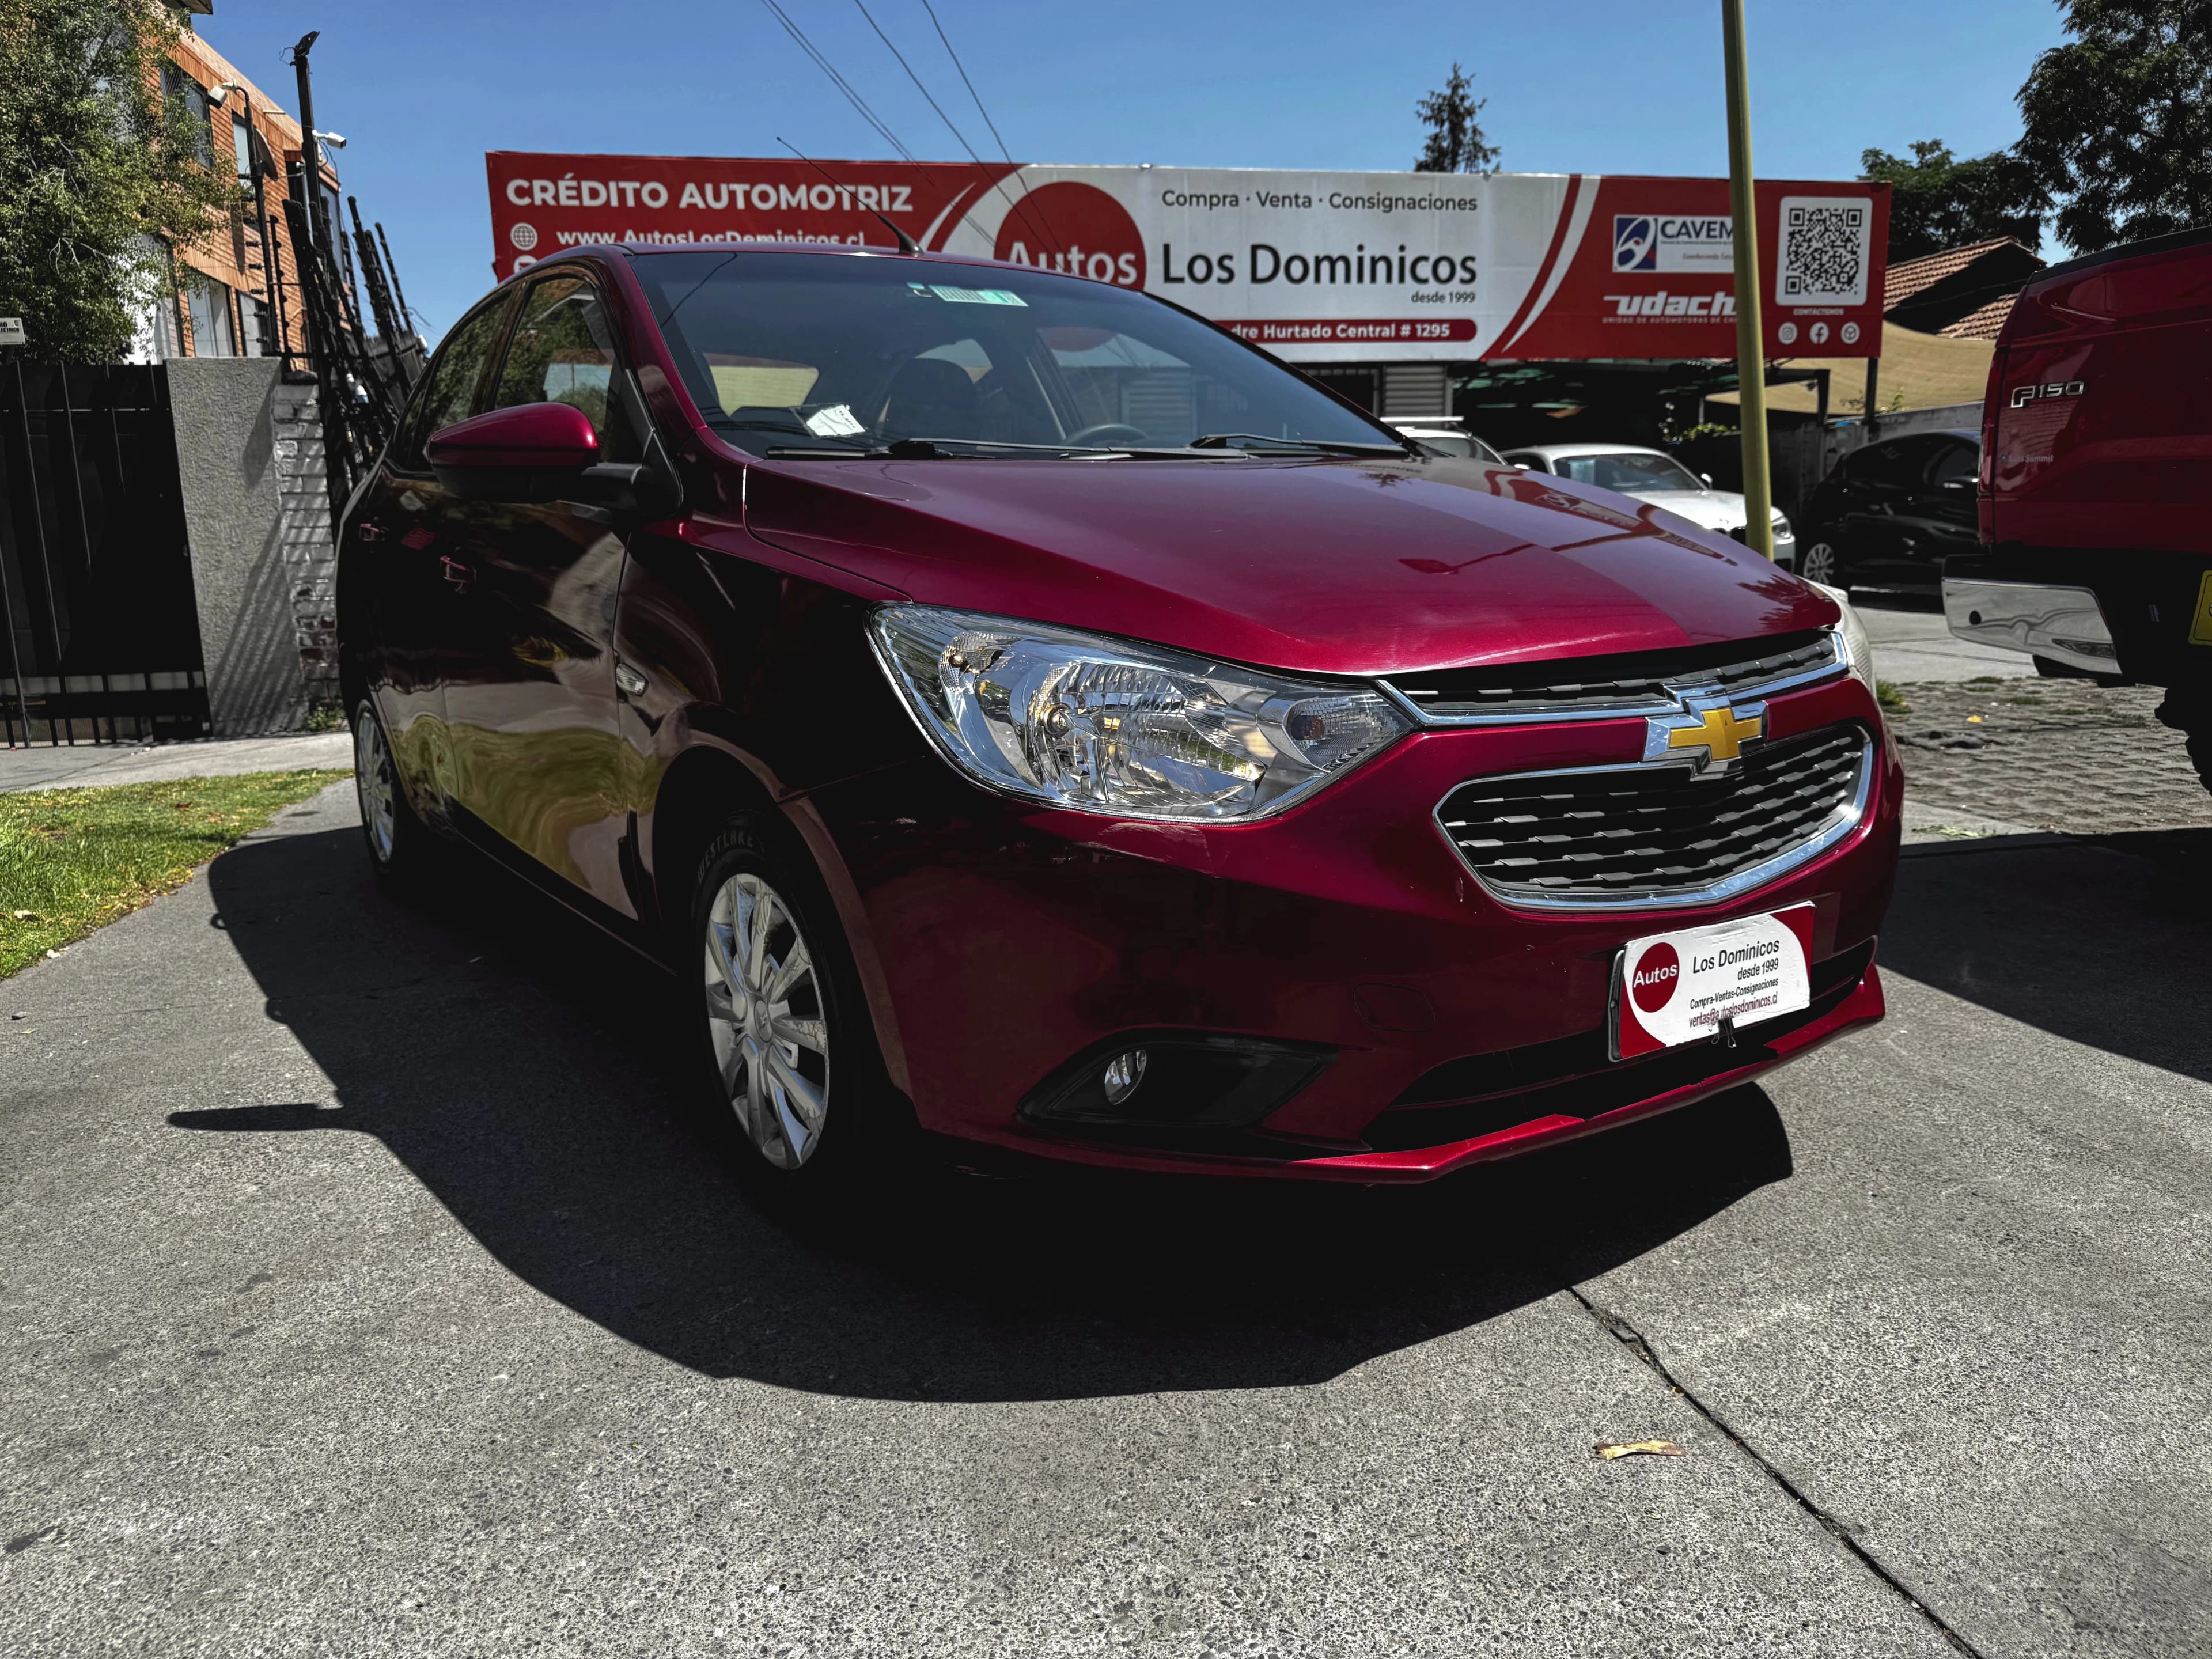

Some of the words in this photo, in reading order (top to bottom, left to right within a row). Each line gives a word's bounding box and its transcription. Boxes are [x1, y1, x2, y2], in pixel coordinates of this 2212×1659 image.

[506, 173, 669, 209] CRÉDITO
[679, 182, 914, 213] AUTOMOTRIZ
[1162, 190, 1240, 211] Compra
[1256, 191, 1312, 208] Venta
[1329, 192, 1478, 213] Consignaciones
[1009, 240, 1138, 285] Autos
[1162, 243, 1235, 284] Los
[1250, 243, 1478, 285] Dominicos
[1411, 291, 1445, 303] desde
[1449, 291, 1476, 303] 1999
[1263, 324, 1331, 339] Hurtado
[1336, 323, 1396, 338] Central
[1400, 324, 1411, 337] #
[1415, 323, 1450, 337] 1295
[697, 830, 753, 885] WESTLAKE
[1692, 955, 1715, 974] Los
[1718, 939, 1780, 968] Dominicos
[1737, 961, 1760, 981] desde
[1762, 957, 1779, 976] 1999
[1633, 963, 1678, 988] Autos
[1690, 978, 1779, 1010] Compra-Ventas-Consignaciones
